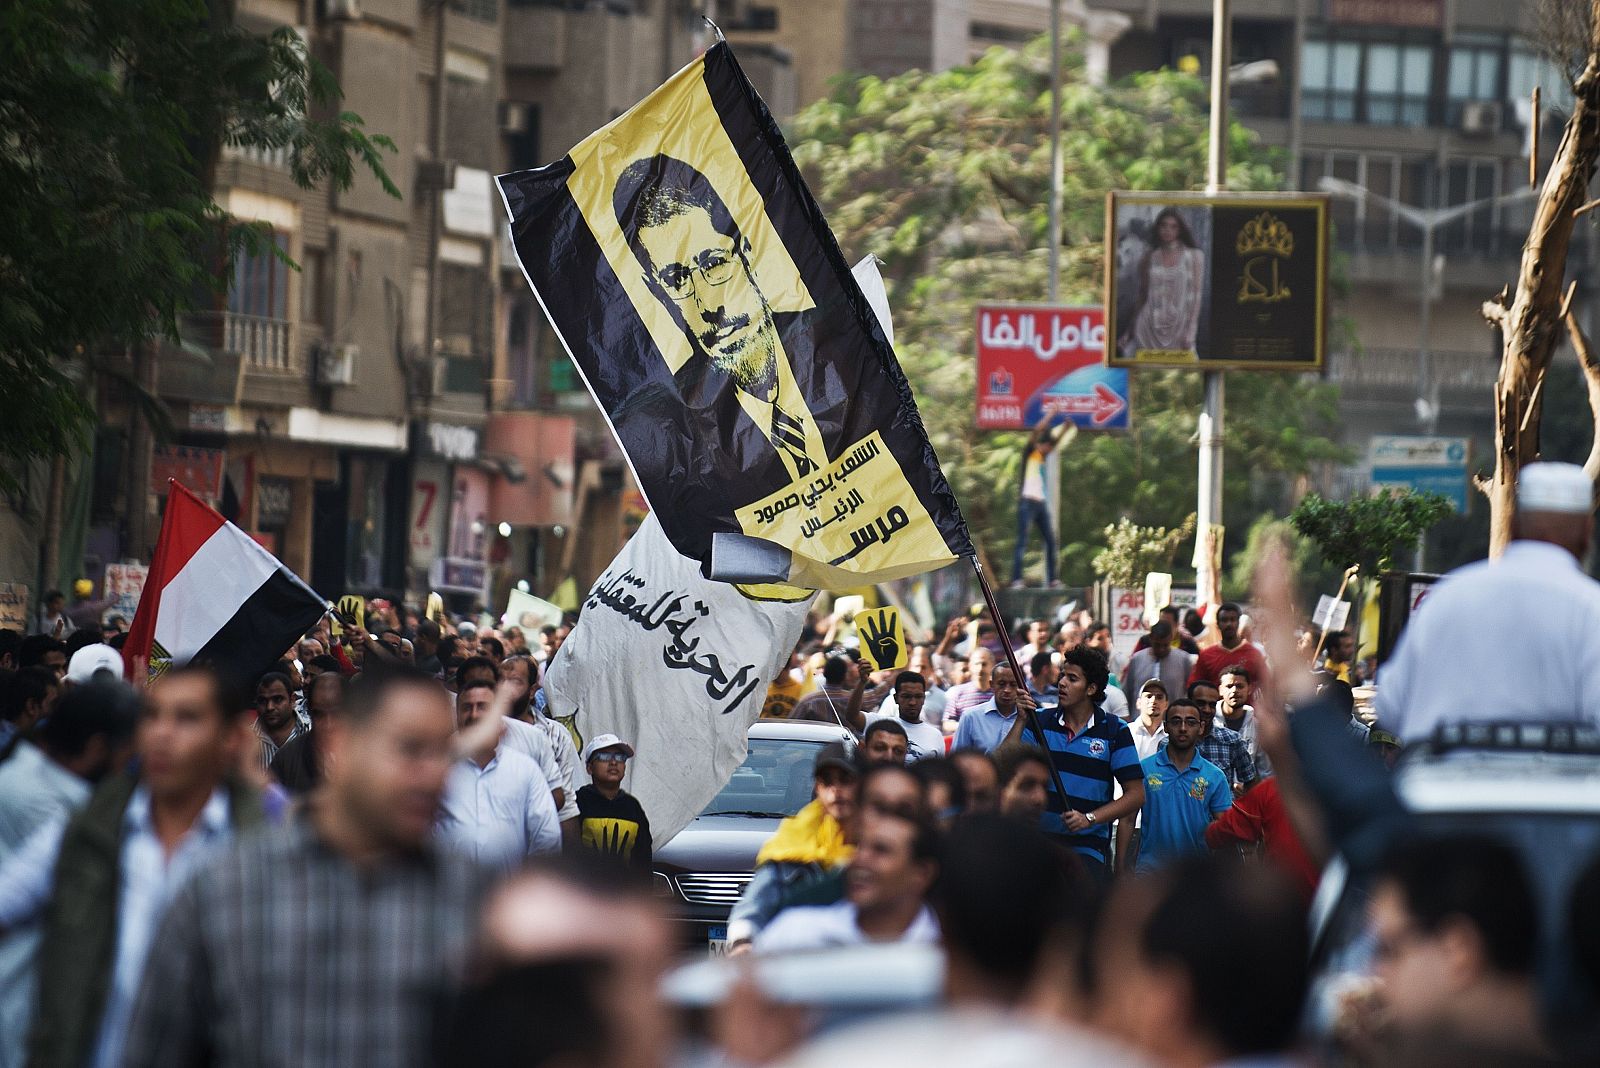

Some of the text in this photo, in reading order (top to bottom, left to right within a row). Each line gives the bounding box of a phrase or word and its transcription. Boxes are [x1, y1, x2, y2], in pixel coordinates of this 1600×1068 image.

[1034, 315, 1105, 361] عامل
[833, 438, 881, 483] الشعب
[753, 492, 800, 524] صمود
[800, 487, 865, 539] الرئيس
[827, 505, 910, 567] مرس
